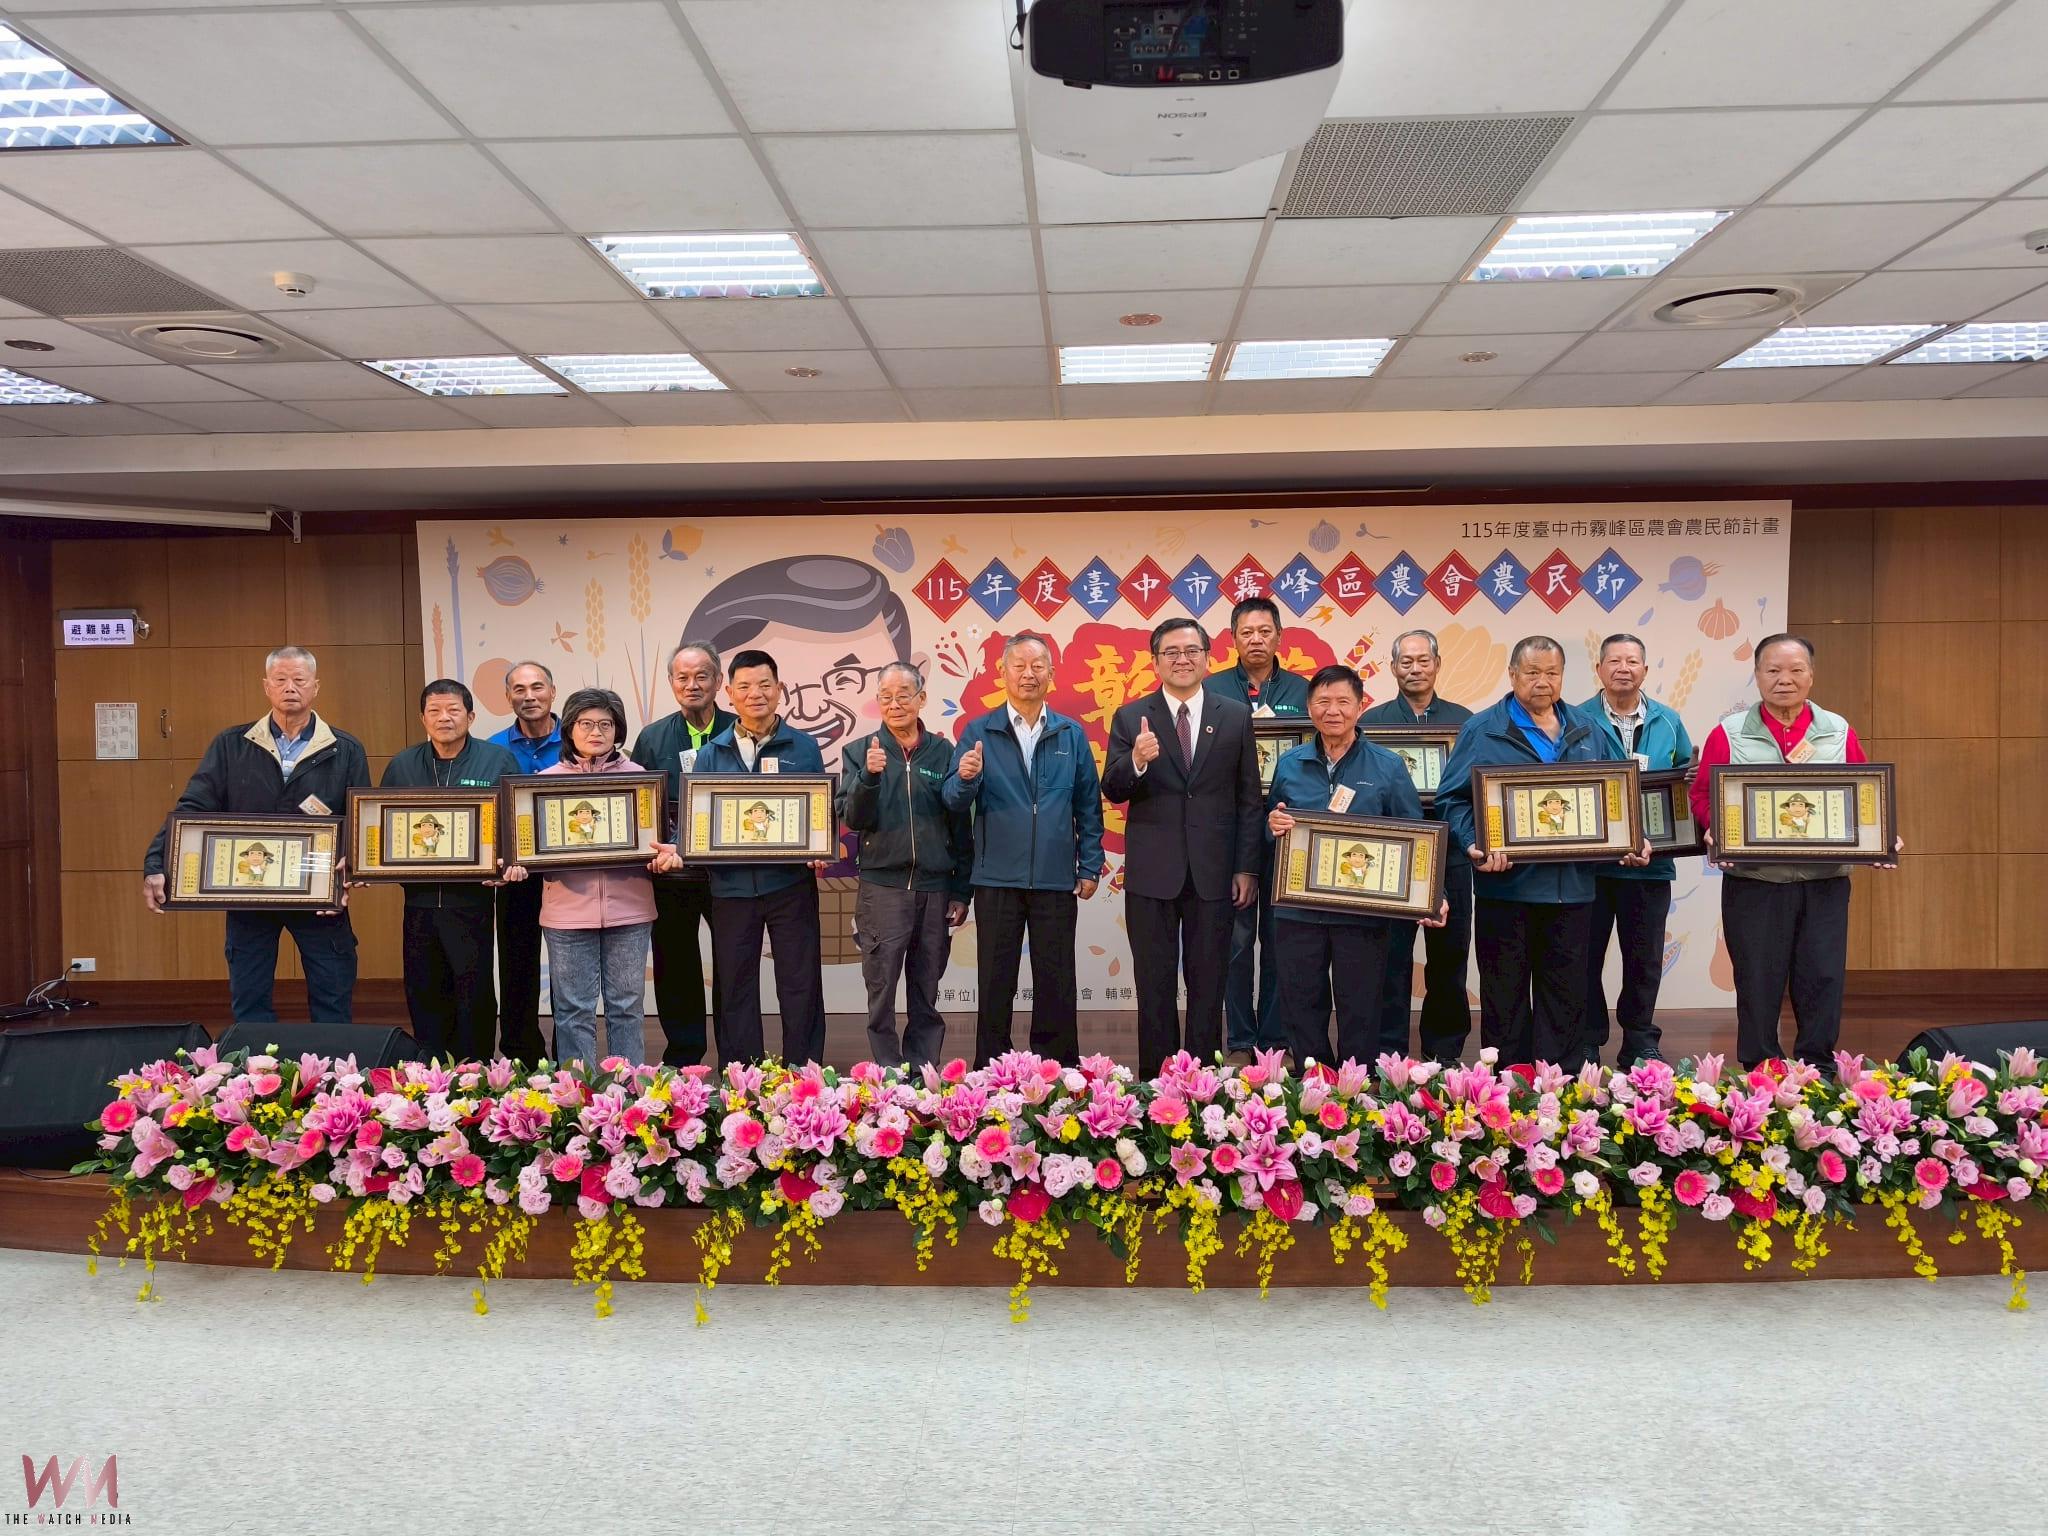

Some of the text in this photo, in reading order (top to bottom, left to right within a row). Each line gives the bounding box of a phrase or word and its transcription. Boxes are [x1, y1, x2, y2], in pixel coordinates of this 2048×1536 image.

[1461, 517, 1781, 538] 115年度臺中市霧峰區農會農民節計畫
[71, 623, 126, 635] 避難器具
